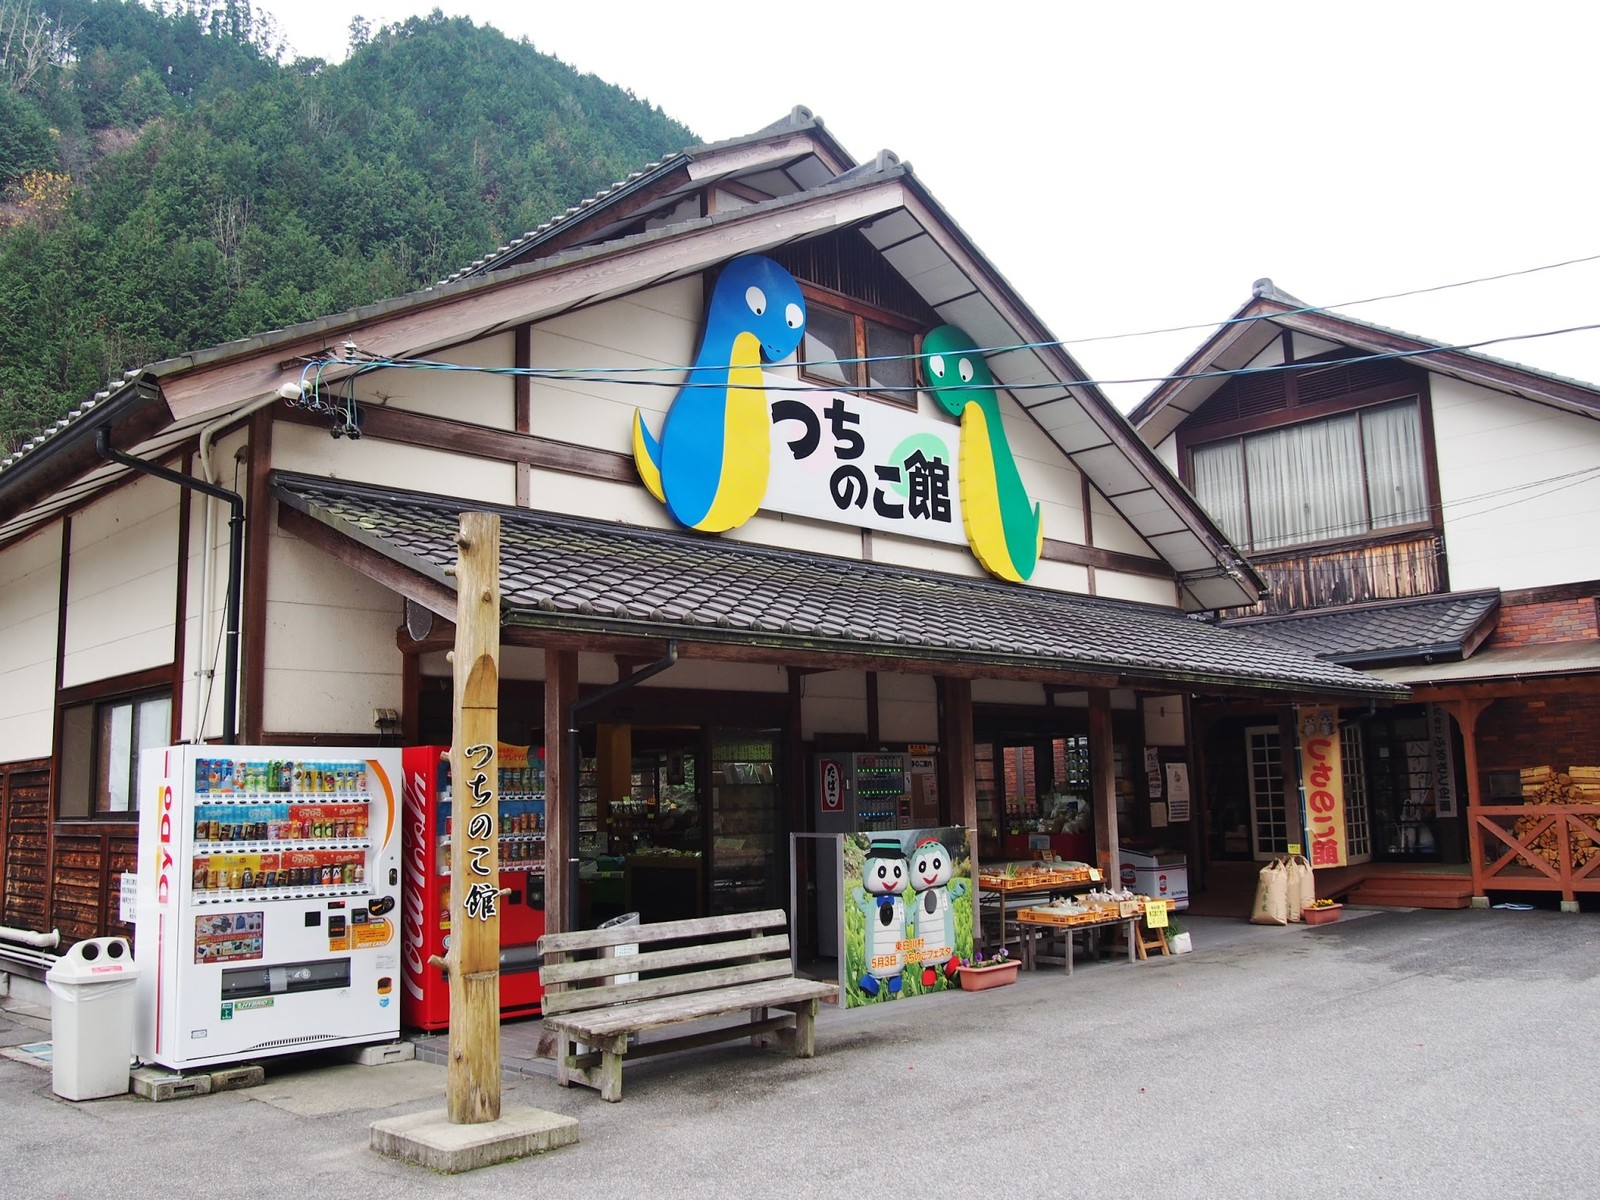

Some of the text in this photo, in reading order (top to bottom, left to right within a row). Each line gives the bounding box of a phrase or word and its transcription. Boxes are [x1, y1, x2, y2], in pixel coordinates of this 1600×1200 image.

[771, 398, 865, 460] つち
[830, 449, 952, 523] のこ館
[826, 765, 838, 805] たばこ
[464, 743, 500, 922] つちのこ館
[871, 946, 952, 969] 5月3日 つちのこフェスタ
[895, 938, 925, 952] 東白川村
